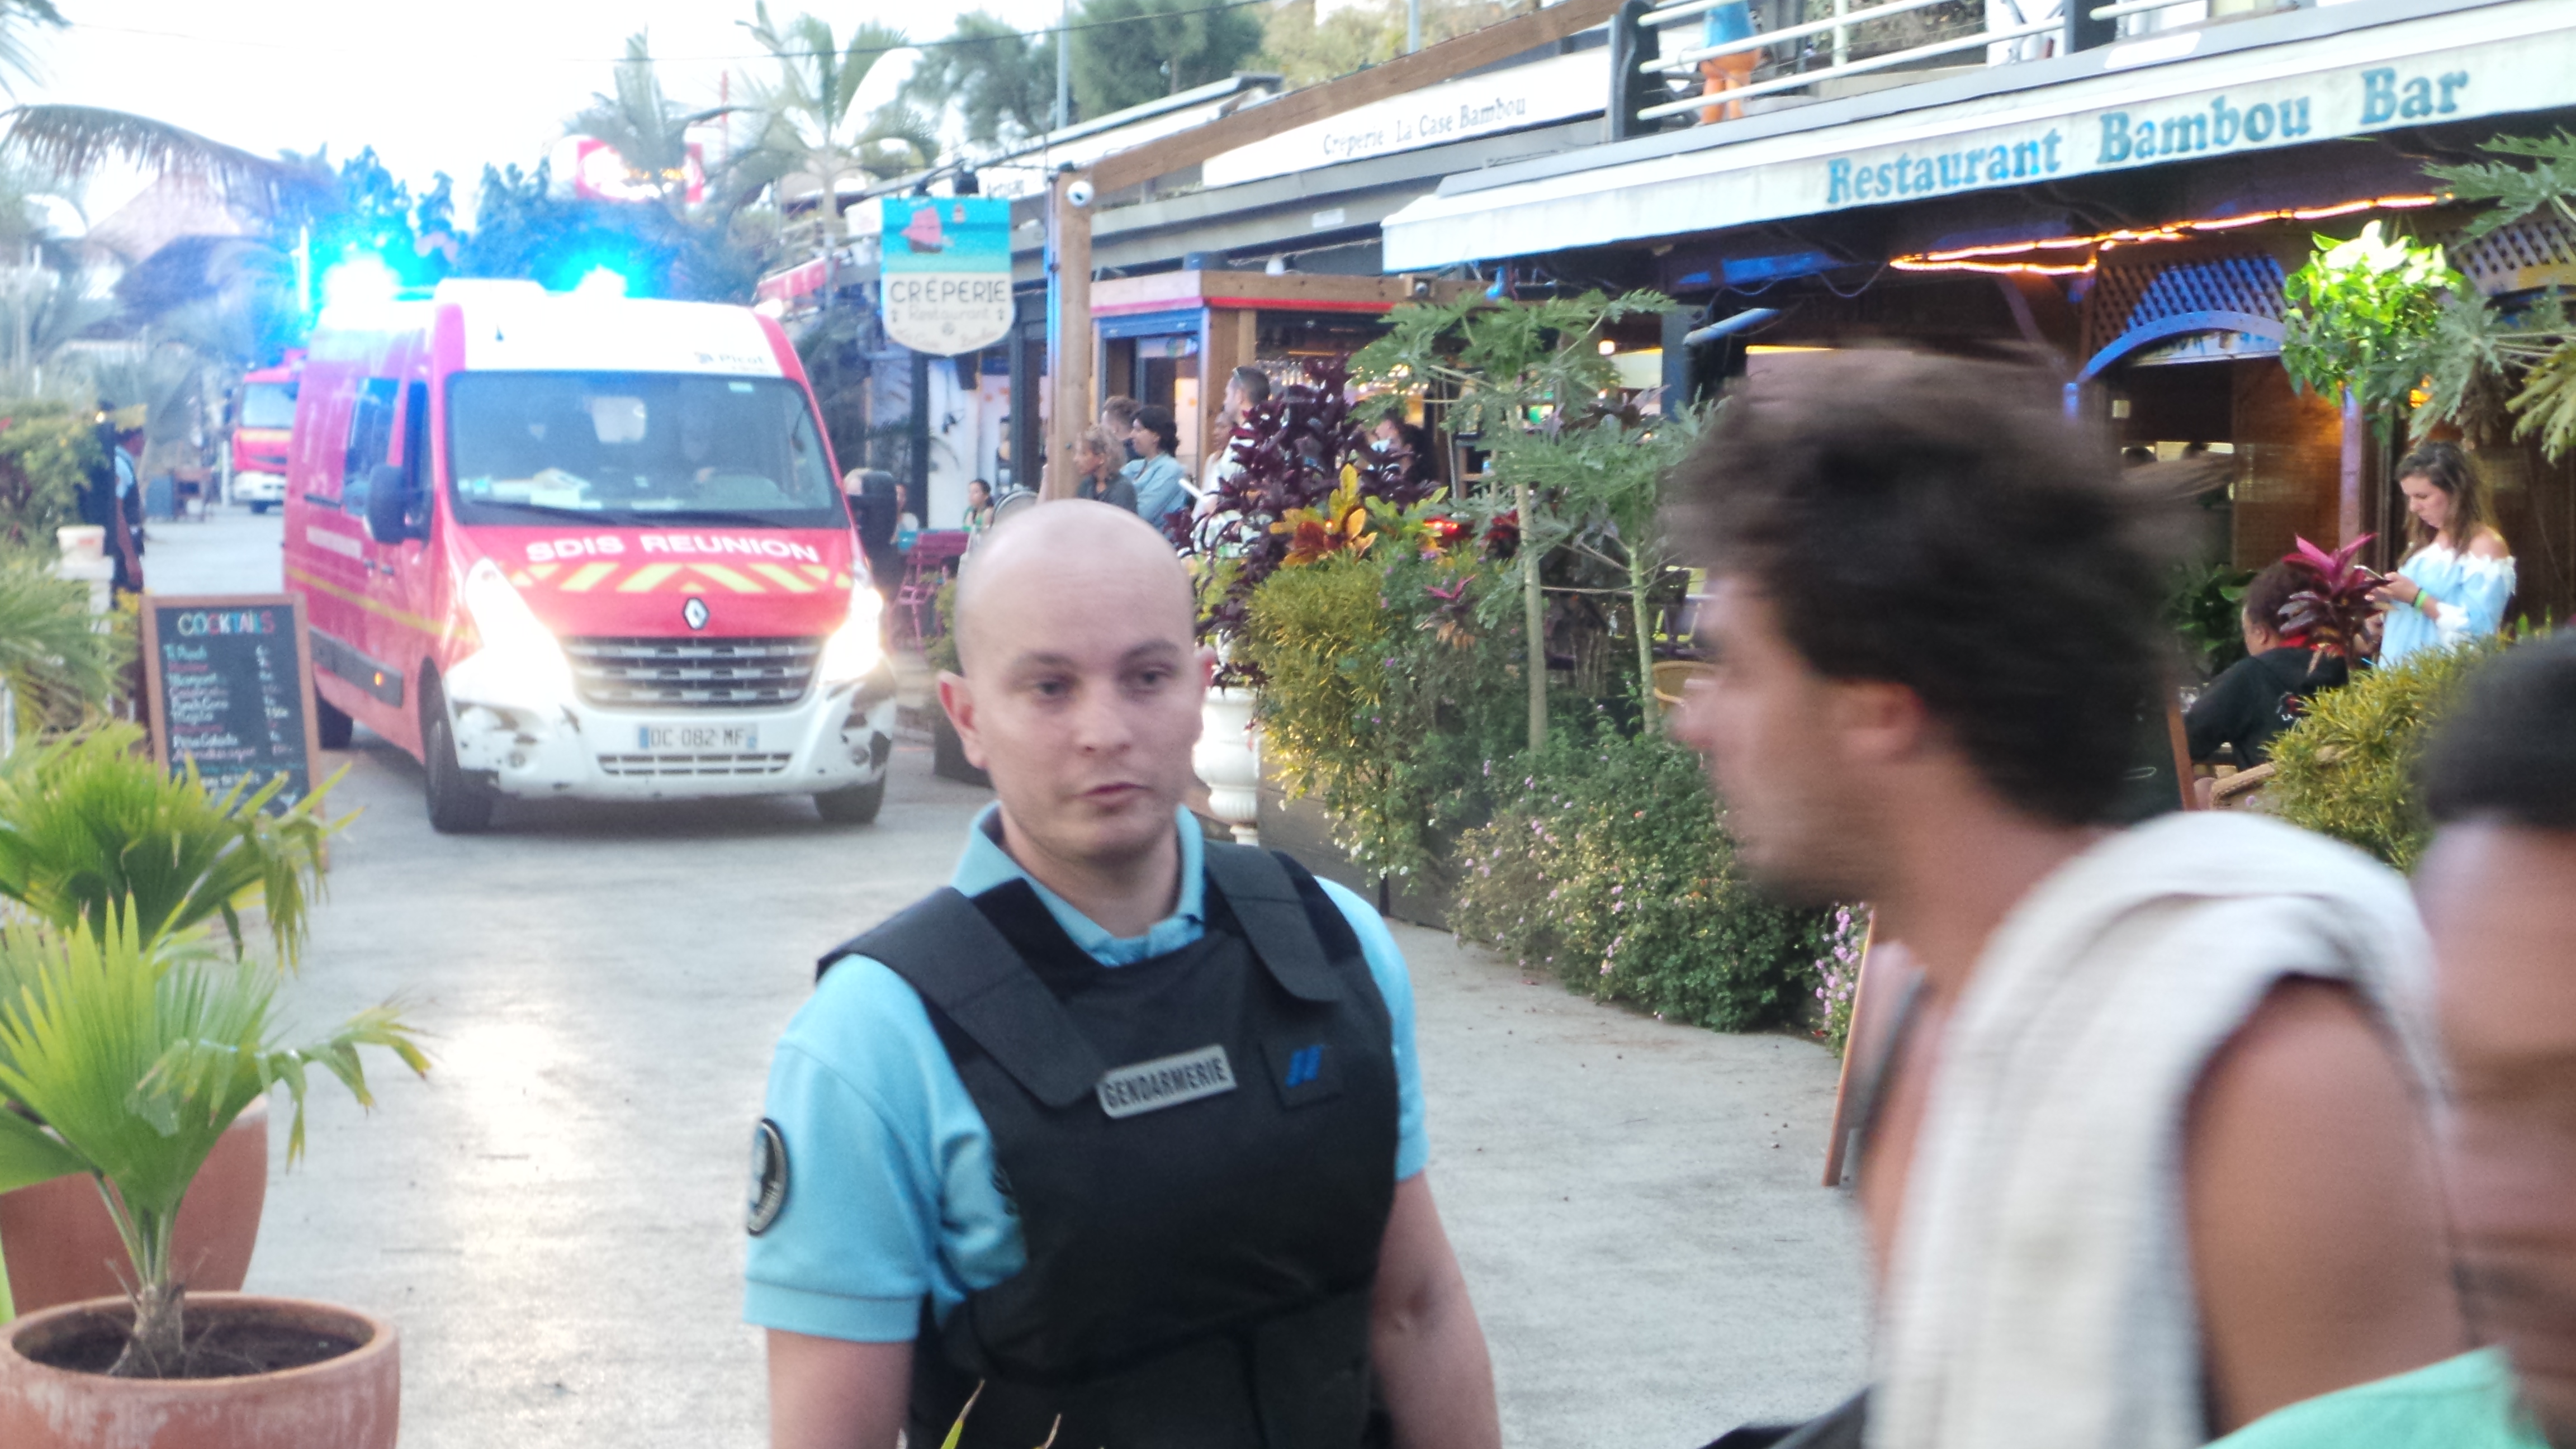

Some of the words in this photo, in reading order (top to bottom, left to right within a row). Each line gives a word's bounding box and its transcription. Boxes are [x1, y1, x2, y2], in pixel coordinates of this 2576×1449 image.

[1396, 119, 1413, 143] La
[1419, 113, 1453, 137] Case
[1459, 96, 1526, 129] Bambou
[1827, 127, 2063, 205] Restaurant
[2096, 94, 2311, 164] Bambou
[2359, 67, 2469, 125] Bar
[526, 534, 625, 562] SDIS
[639, 534, 820, 564] REUNION
[177, 609, 276, 637] COCKTAILS
[681, 728, 717, 747] 082
[1105, 1057, 1229, 1110] GENDARMERIE
